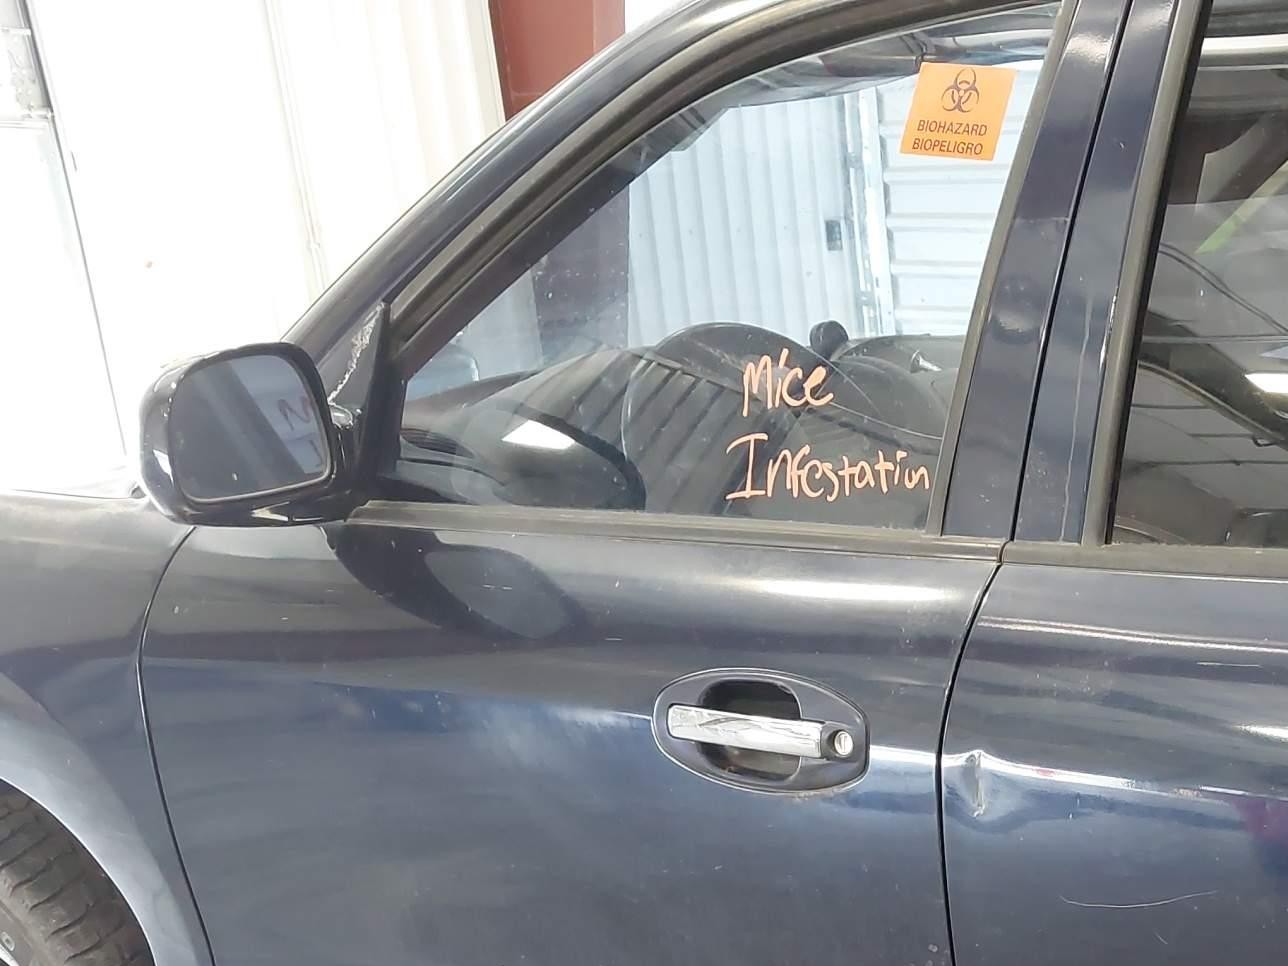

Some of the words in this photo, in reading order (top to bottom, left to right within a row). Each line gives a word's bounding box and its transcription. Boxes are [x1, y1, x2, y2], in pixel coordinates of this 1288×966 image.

[917, 119, 988, 137] BIOHAZARD
[912, 137, 984, 156] BIOPELIGRO
[742, 347, 834, 418] Mice
